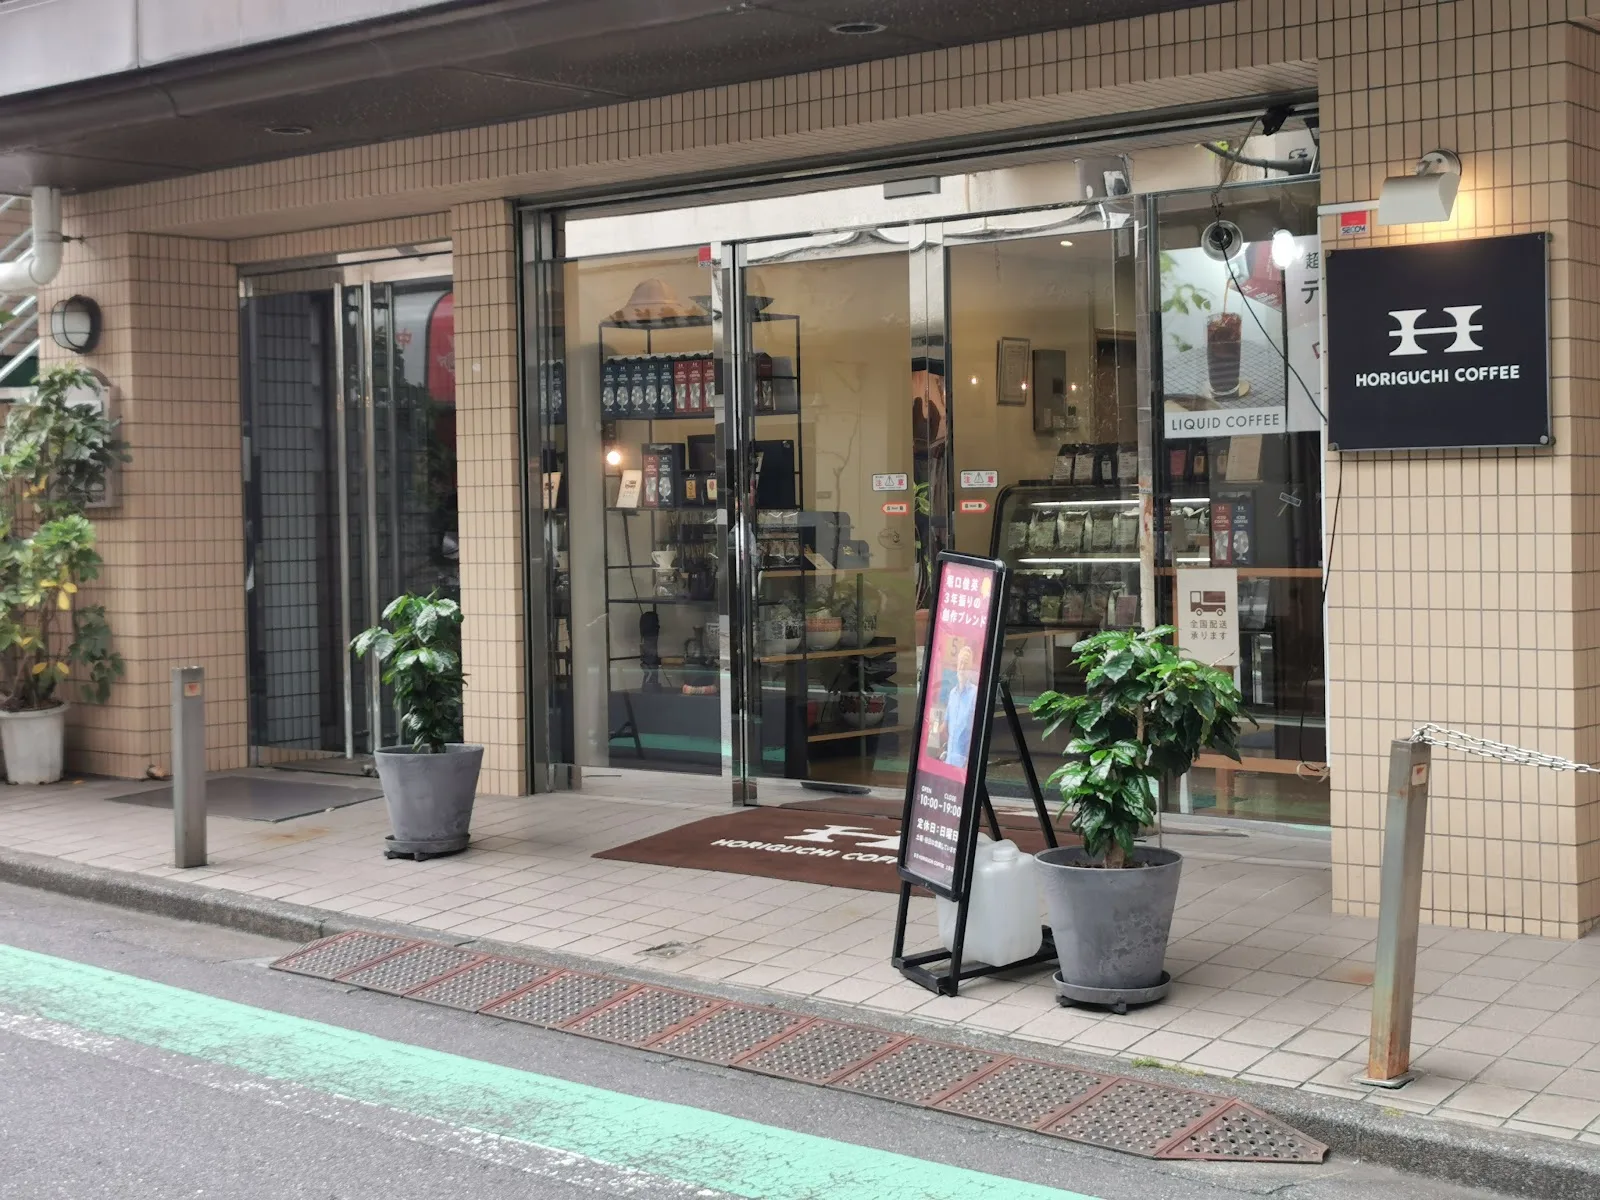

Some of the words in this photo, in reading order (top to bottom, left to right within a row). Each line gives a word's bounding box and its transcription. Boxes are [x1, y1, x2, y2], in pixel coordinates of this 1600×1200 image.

[1341, 225, 1366, 234] SECOM
[1355, 368, 1449, 388] HORIGUCHI
[1454, 364, 1520, 383] COFFEE
[1172, 417, 1221, 431] LIQUID
[1226, 413, 1280, 428] COFFEE
[942, 608, 987, 628] 創作ブレンド
[1190, 620, 1228, 629] 全国配送
[1190, 631, 1227, 640] 承ります
[921, 785, 932, 794] OPEN
[944, 792, 957, 803] CLOSE
[710, 838, 842, 858] HORIGUCHI
